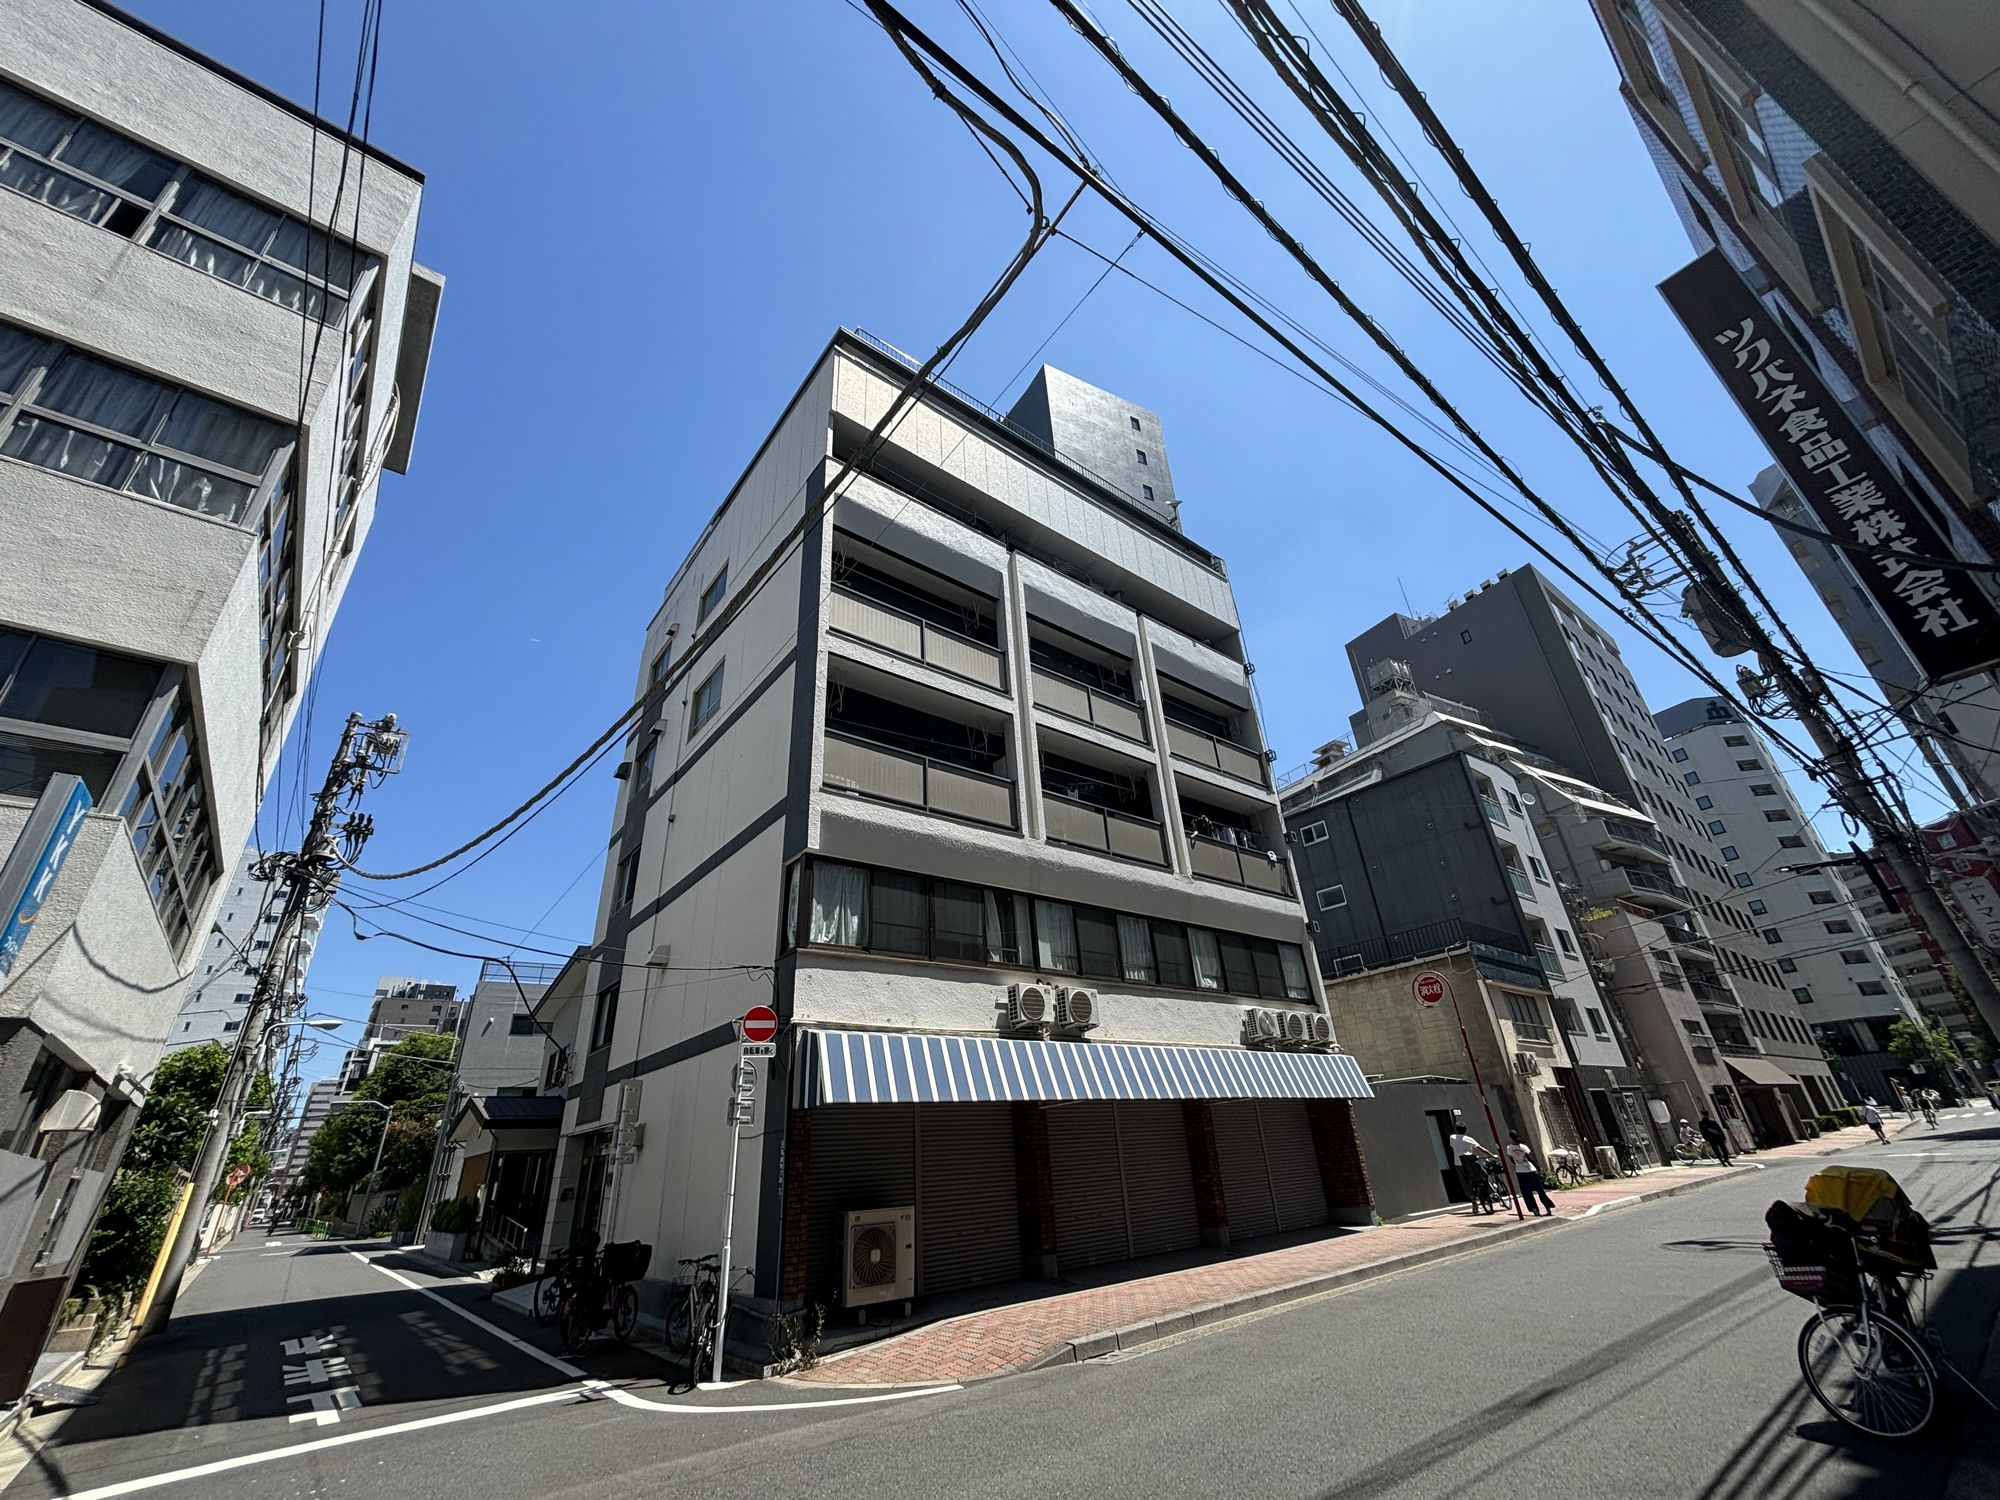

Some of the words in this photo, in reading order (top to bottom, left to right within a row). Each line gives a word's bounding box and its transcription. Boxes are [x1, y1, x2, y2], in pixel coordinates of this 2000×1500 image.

[1715, 318, 1978, 636] ツクバネ食品工業株式会社
[33, 799, 86, 903] YKK
[1419, 984, 1442, 996] 消火栓
[278, 1334, 363, 1426] 止まれ
